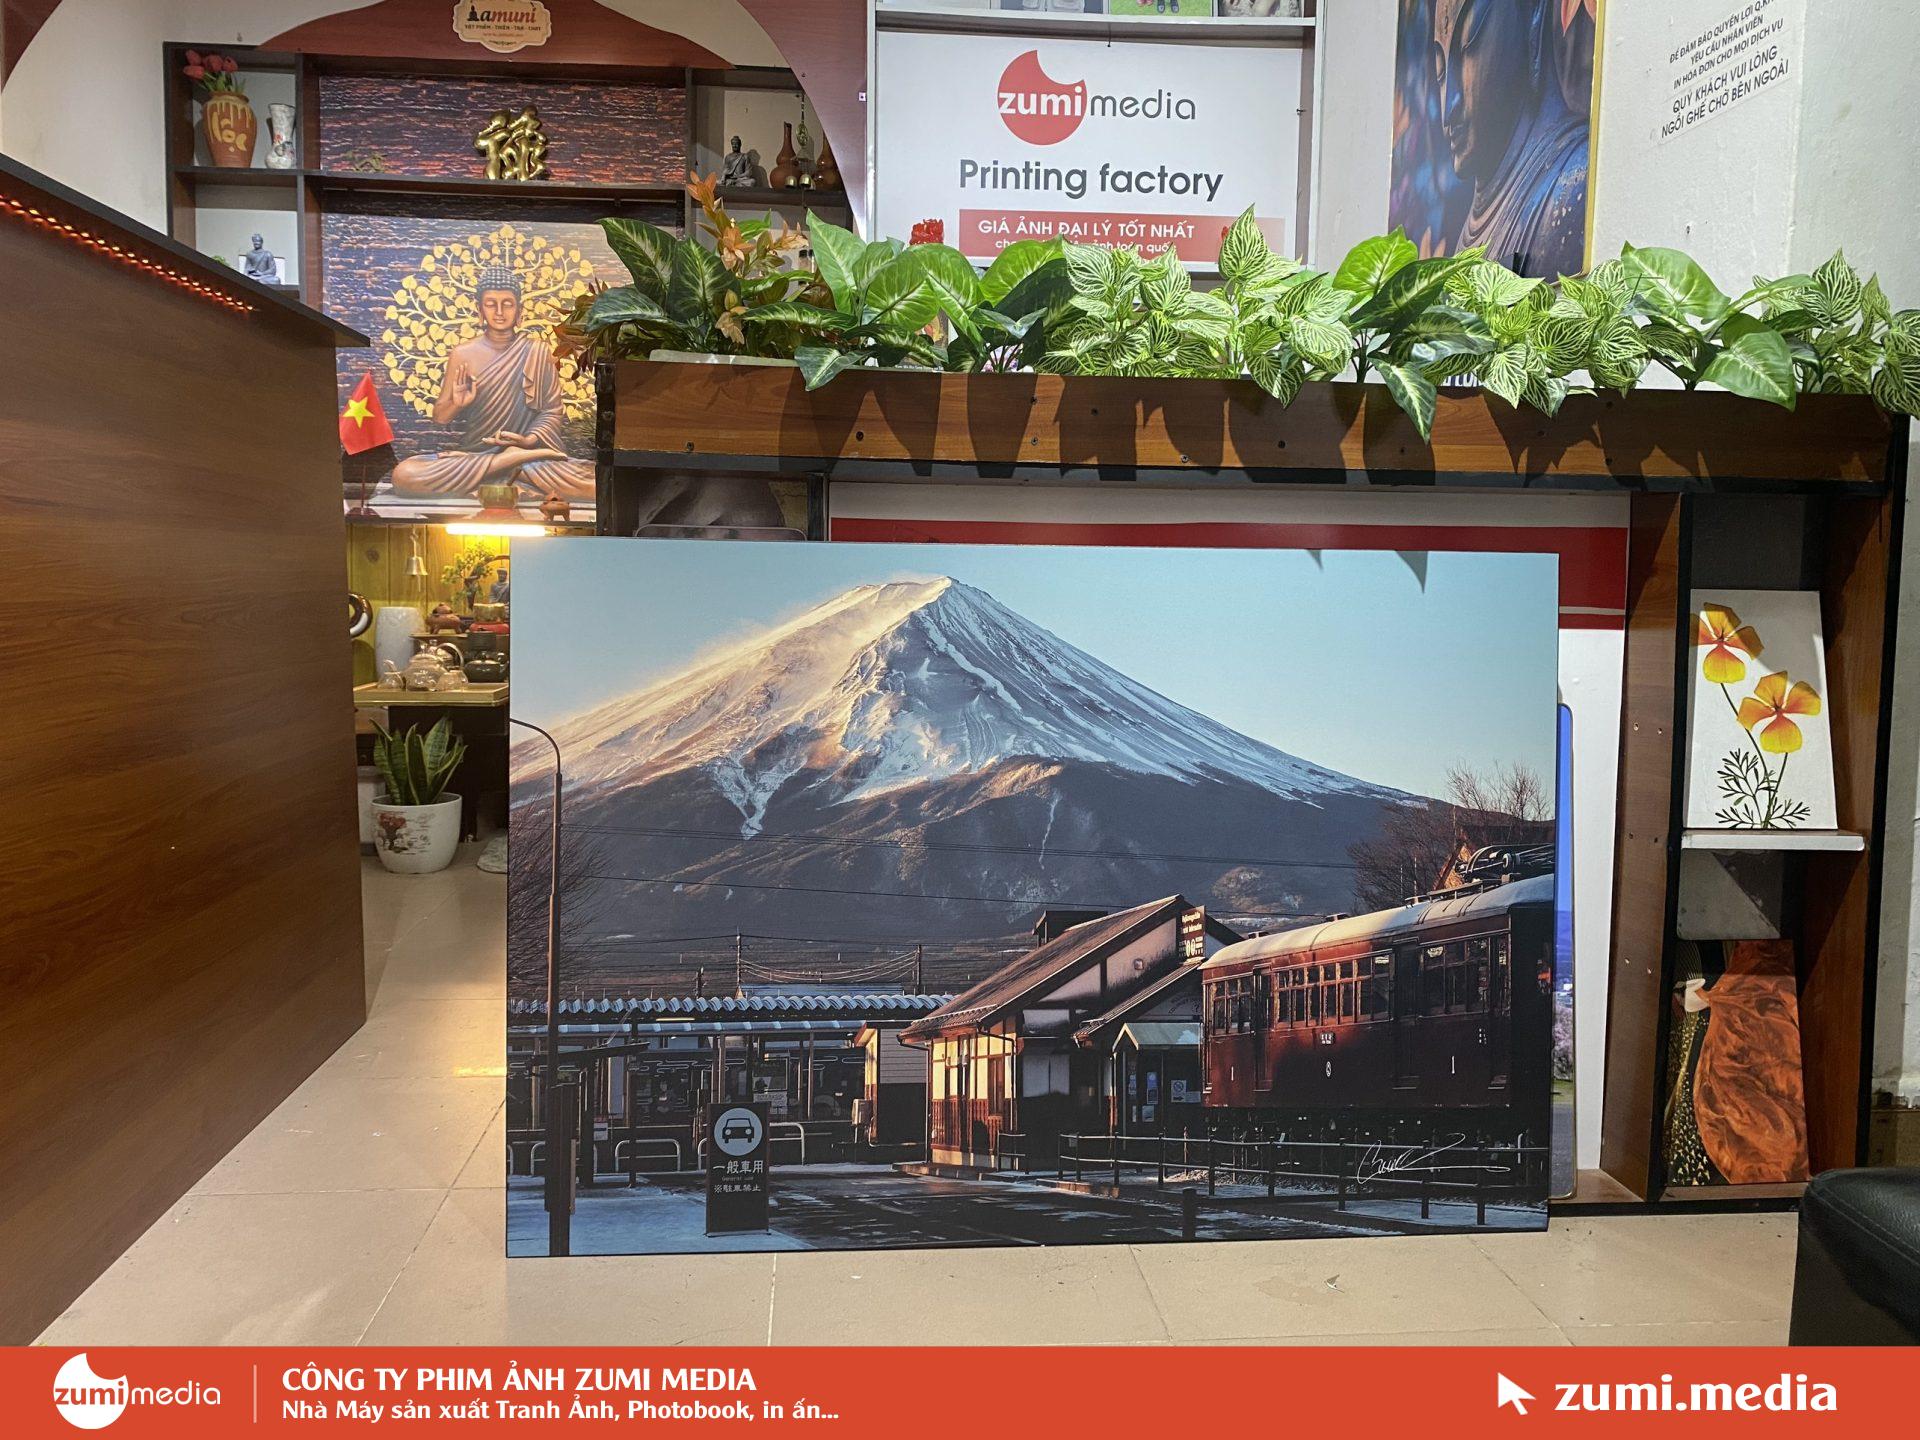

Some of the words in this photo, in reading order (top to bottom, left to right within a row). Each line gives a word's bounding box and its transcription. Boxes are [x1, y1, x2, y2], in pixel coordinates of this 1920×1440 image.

[1673, 77, 1681, 89] IN
[1698, 58, 1715, 75] ĐƠN
[1716, 49, 1732, 64] CHO
[1734, 40, 1750, 53] MỌI
[1751, 29, 1770, 46] DỊCH
[1771, 18, 1784, 32] VỤ
[1690, 49, 1704, 65] YÊU
[1705, 39, 1721, 56] CẦU
[1721, 27, 1744, 47] NHÂN
[1746, 14, 1763, 32] VIÊN
[1697, 30, 1712, 47] BẢO
[1695, 73, 1728, 102] KHÁCH
[1730, 62, 1747, 82] VUI
[1749, 45, 1778, 72] LÒNG
[1661, 112, 1684, 138] NGỒI
[1686, 99, 1706, 125] GHẾ
[1731, 79, 1752, 102] BÊN
[1753, 58, 1789, 90] NGOÀI
[959, 159, 1087, 200] Printing
[1100, 162, 1224, 202] factory
[978, 216, 1010, 235] GIÁ
[1015, 215, 1053, 236] ẢNH
[1058, 219, 1088, 238] ĐẠI
[1093, 218, 1113, 236] LÝ
[1118, 217, 1147, 238] TỐT
[1150, 219, 1195, 239] NHẤT
[713, 1160, 764, 1174] 一般車用
